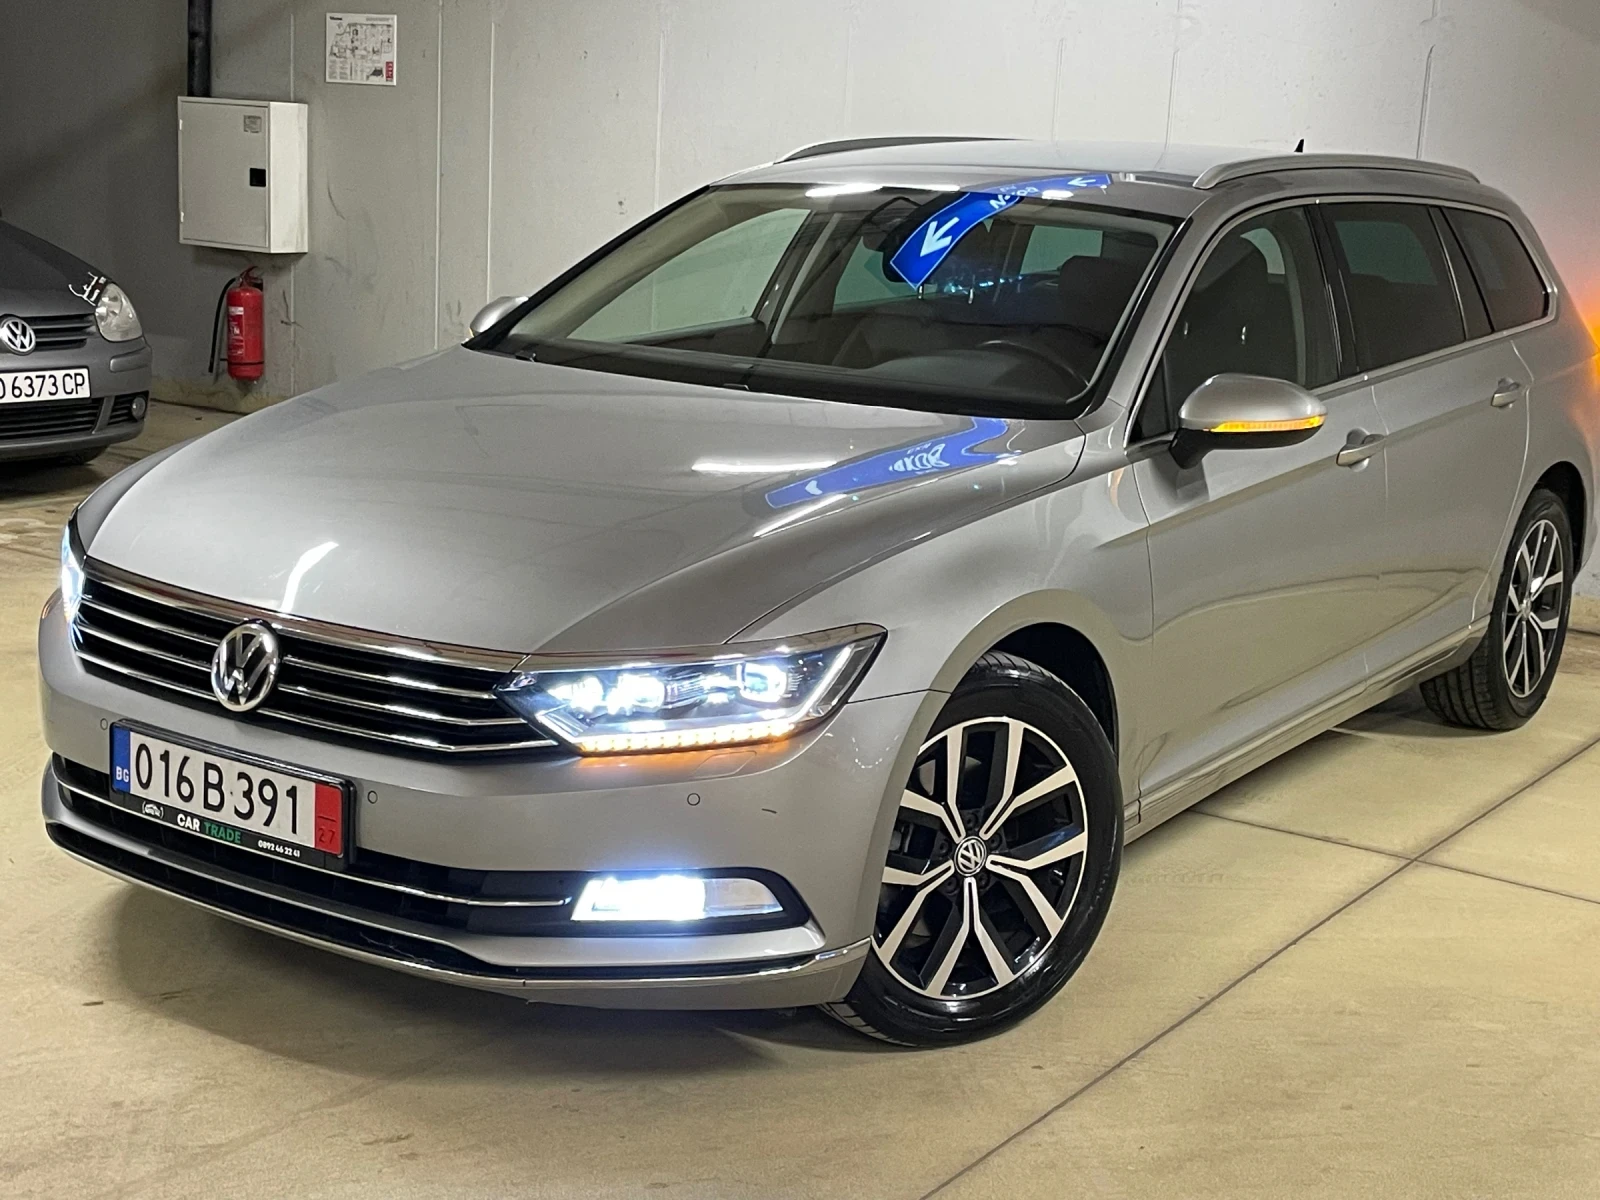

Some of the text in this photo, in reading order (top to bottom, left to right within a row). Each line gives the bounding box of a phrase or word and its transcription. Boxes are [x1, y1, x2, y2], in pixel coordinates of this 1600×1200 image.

[11, 374, 59, 398] 6373
[62, 373, 85, 395] CP
[116, 766, 129, 783] BG
[135, 743, 297, 835] 016B391
[177, 813, 241, 844] CAR TRADE
[318, 827, 336, 845] 27
